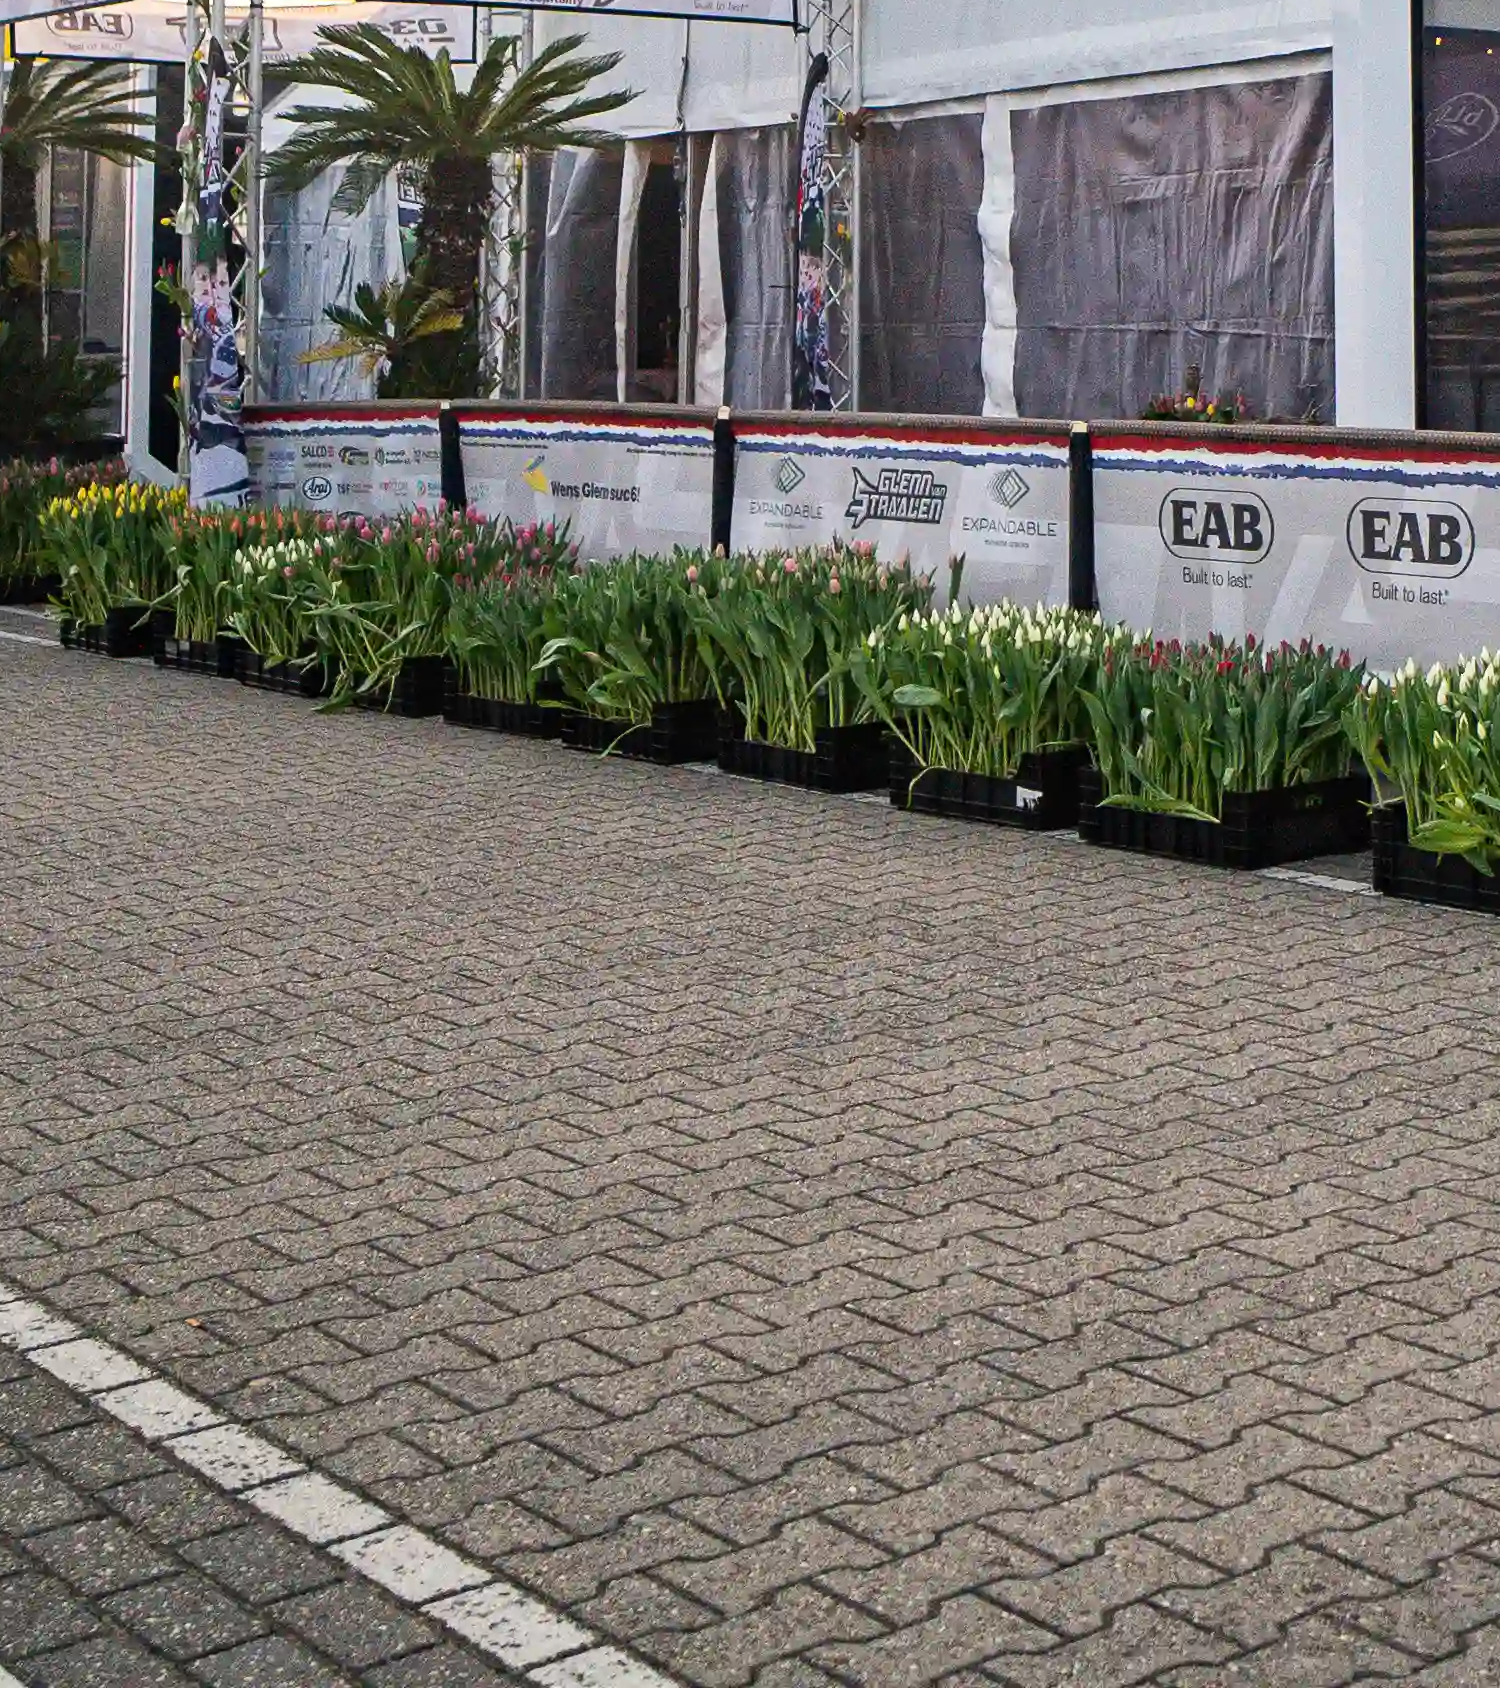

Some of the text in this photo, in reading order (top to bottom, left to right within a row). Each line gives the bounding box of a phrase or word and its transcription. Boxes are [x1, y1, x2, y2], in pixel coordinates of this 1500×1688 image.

[550, 480, 580, 500] Wens
[609, 486, 641, 503] suc6!
[878, 469, 933, 495] GLENN
[748, 499, 824, 520] EXPANDABLE
[961, 516, 1057, 538] EXPANDABLE
[1169, 498, 1265, 553] EAB
[1358, 508, 1464, 566] EAB
[1182, 565, 1206, 586] Built
[1208, 570, 1224, 588] to
[1371, 581, 1399, 602] Built
[1402, 585, 1416, 603] to
